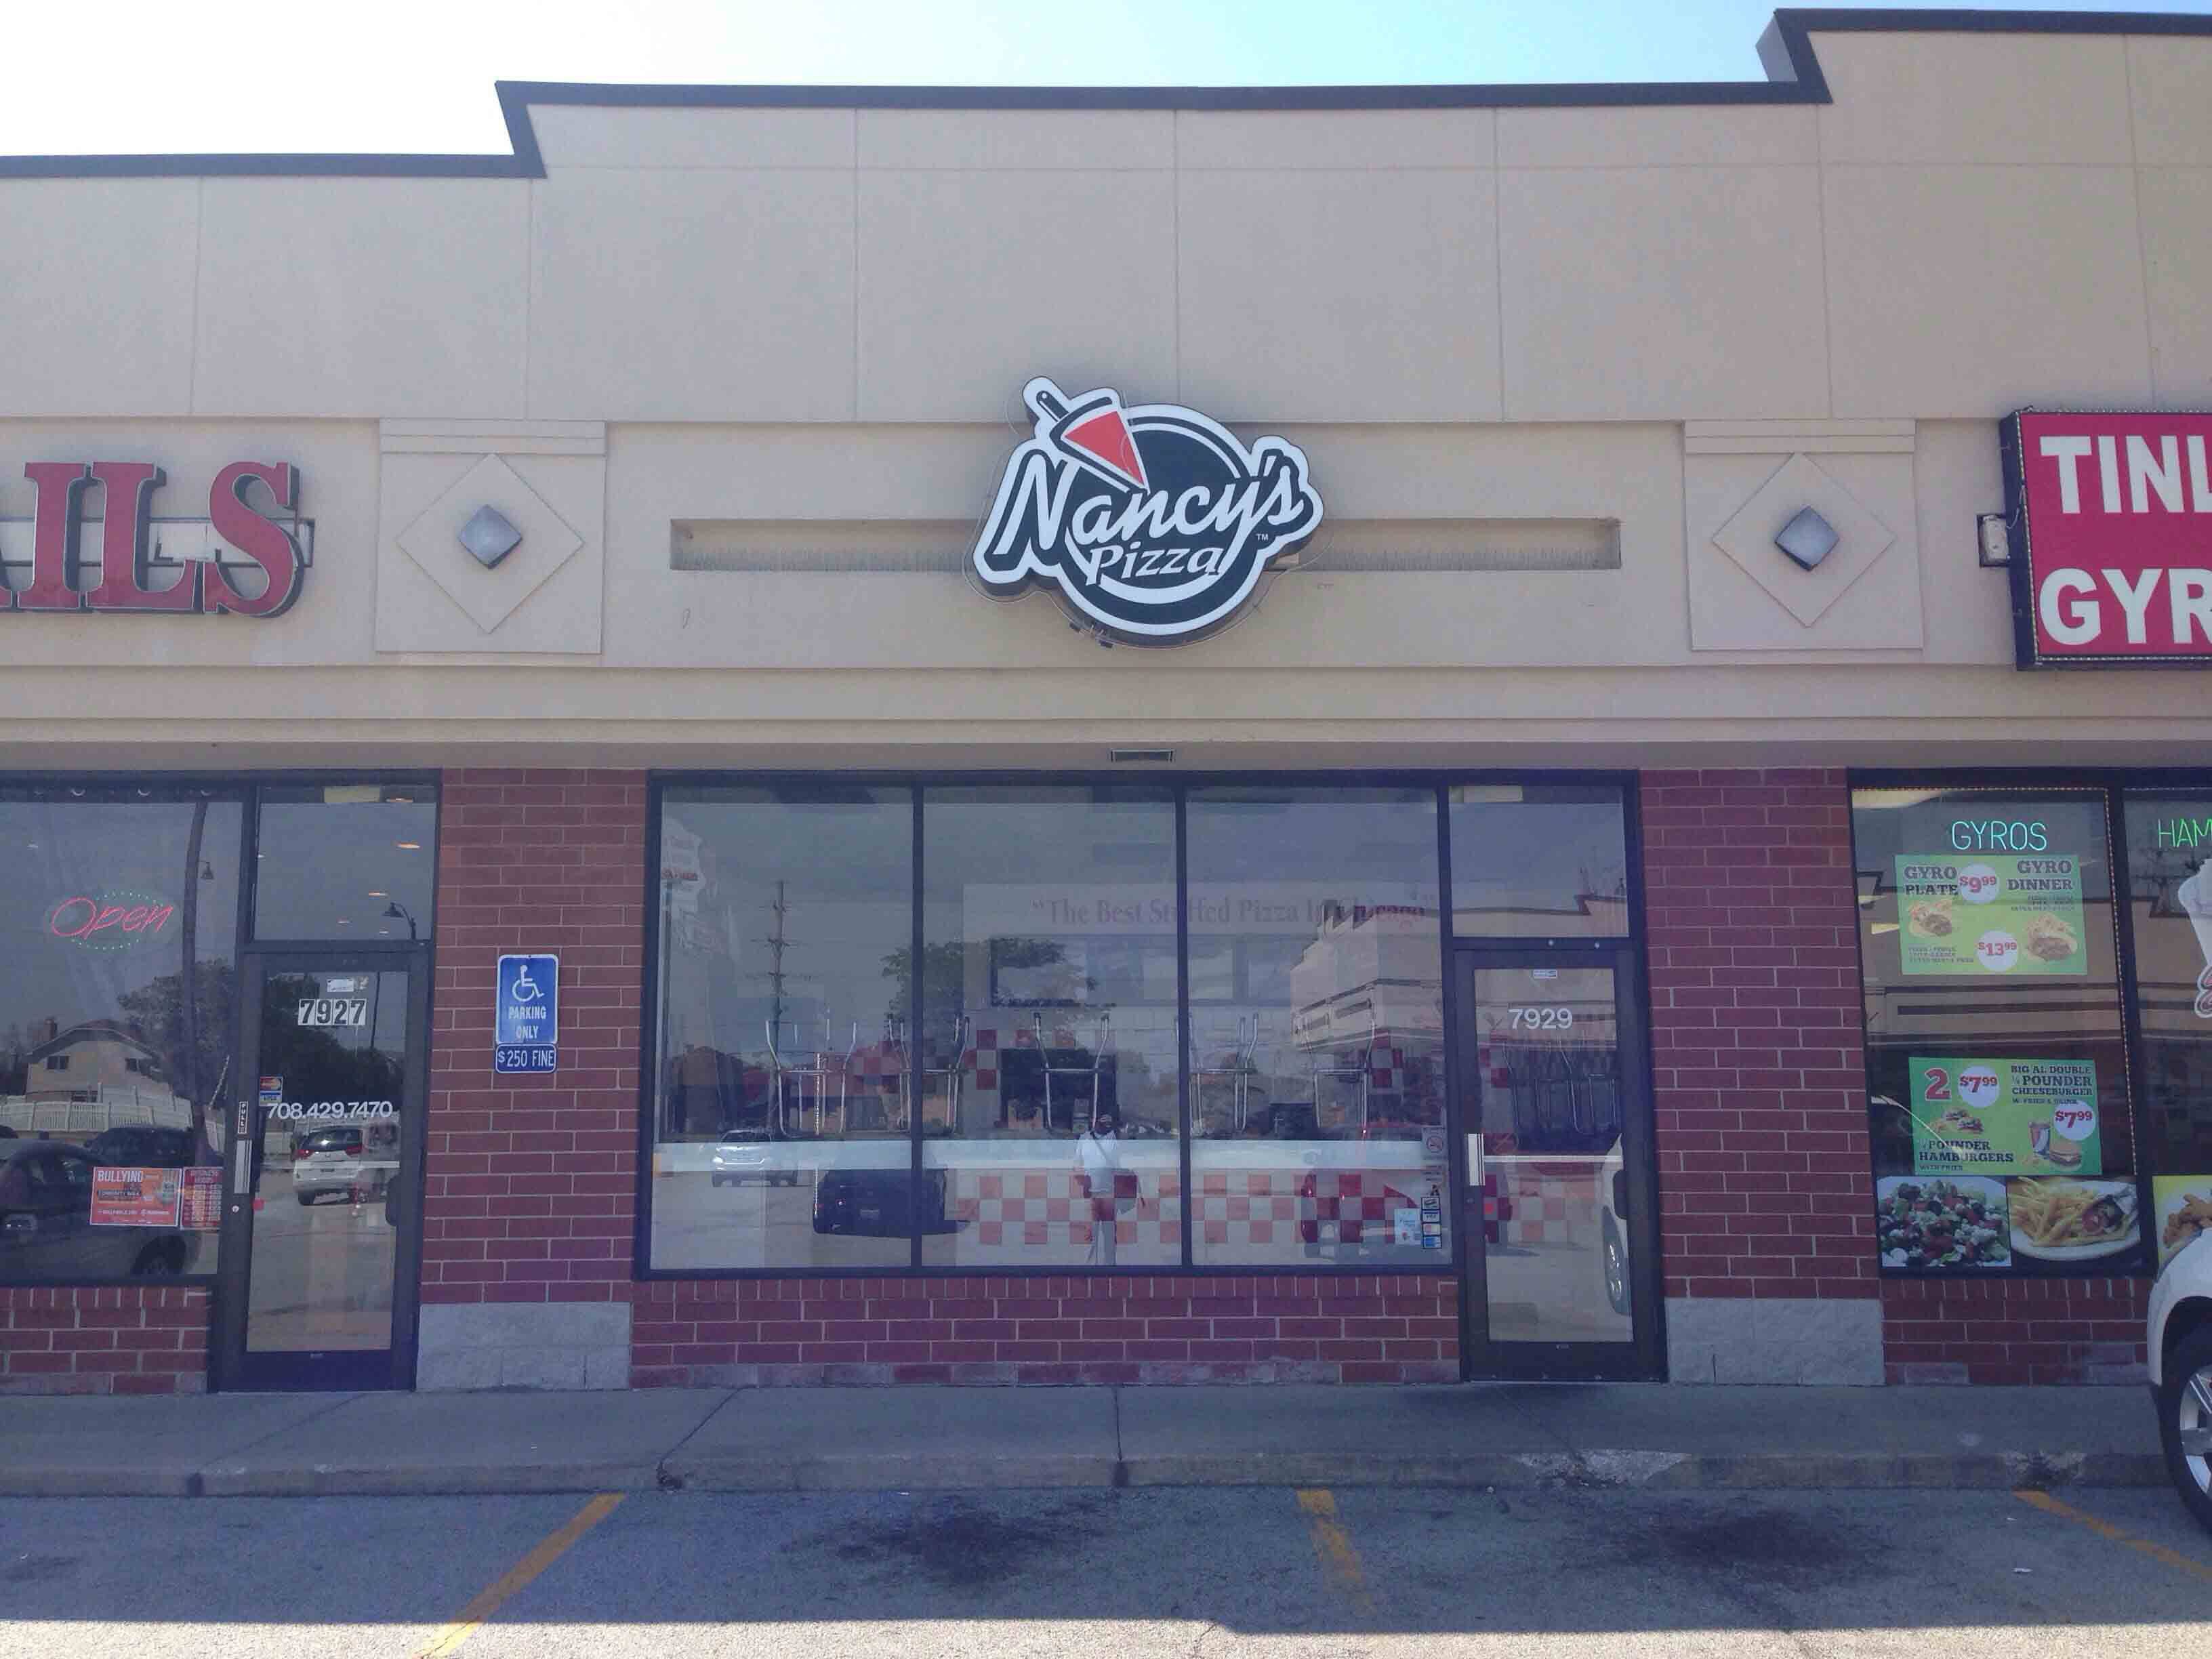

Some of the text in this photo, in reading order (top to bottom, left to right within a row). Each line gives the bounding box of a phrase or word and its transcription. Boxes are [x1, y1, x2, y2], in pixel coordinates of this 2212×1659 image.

[2039, 434, 2212, 514] TINL
[991, 453, 1305, 568] Nancy's
[0, 462, 304, 617] ILS
[1256, 533, 1269, 541] TM
[1085, 541, 1224, 586] Pizza
[2039, 567, 2212, 646] GYR
[1950, 820, 2047, 851] GYROS
[1904, 866, 1958, 880] GYRO
[2017, 860, 2072, 874] GYRO
[1904, 884, 1959, 896] PLATE
[2006, 878, 2073, 891] DINNER
[51, 897, 174, 940] Open
[1096, 898, 1143, 923] Best
[1238, 898, 1298, 922] Pizza
[300, 999, 366, 1025] 7927
[509, 1006, 547, 1020] PARKING
[1508, 1008, 1573, 1029] 7929
[516, 1025, 539, 1039] ONLY
[497, 1049, 554, 1067] $250 FINE
[2011, 1065, 2030, 1074] BIG
[2049, 1065, 2091, 1074] DOUBLE
[1924, 1067, 1952, 1101] 2
[2022, 1076, 2093, 1086] POUNDER
[2011, 1086, 2093, 1097] CHEESEBURGER
[266, 1101, 393, 1119] 708.429.7470
